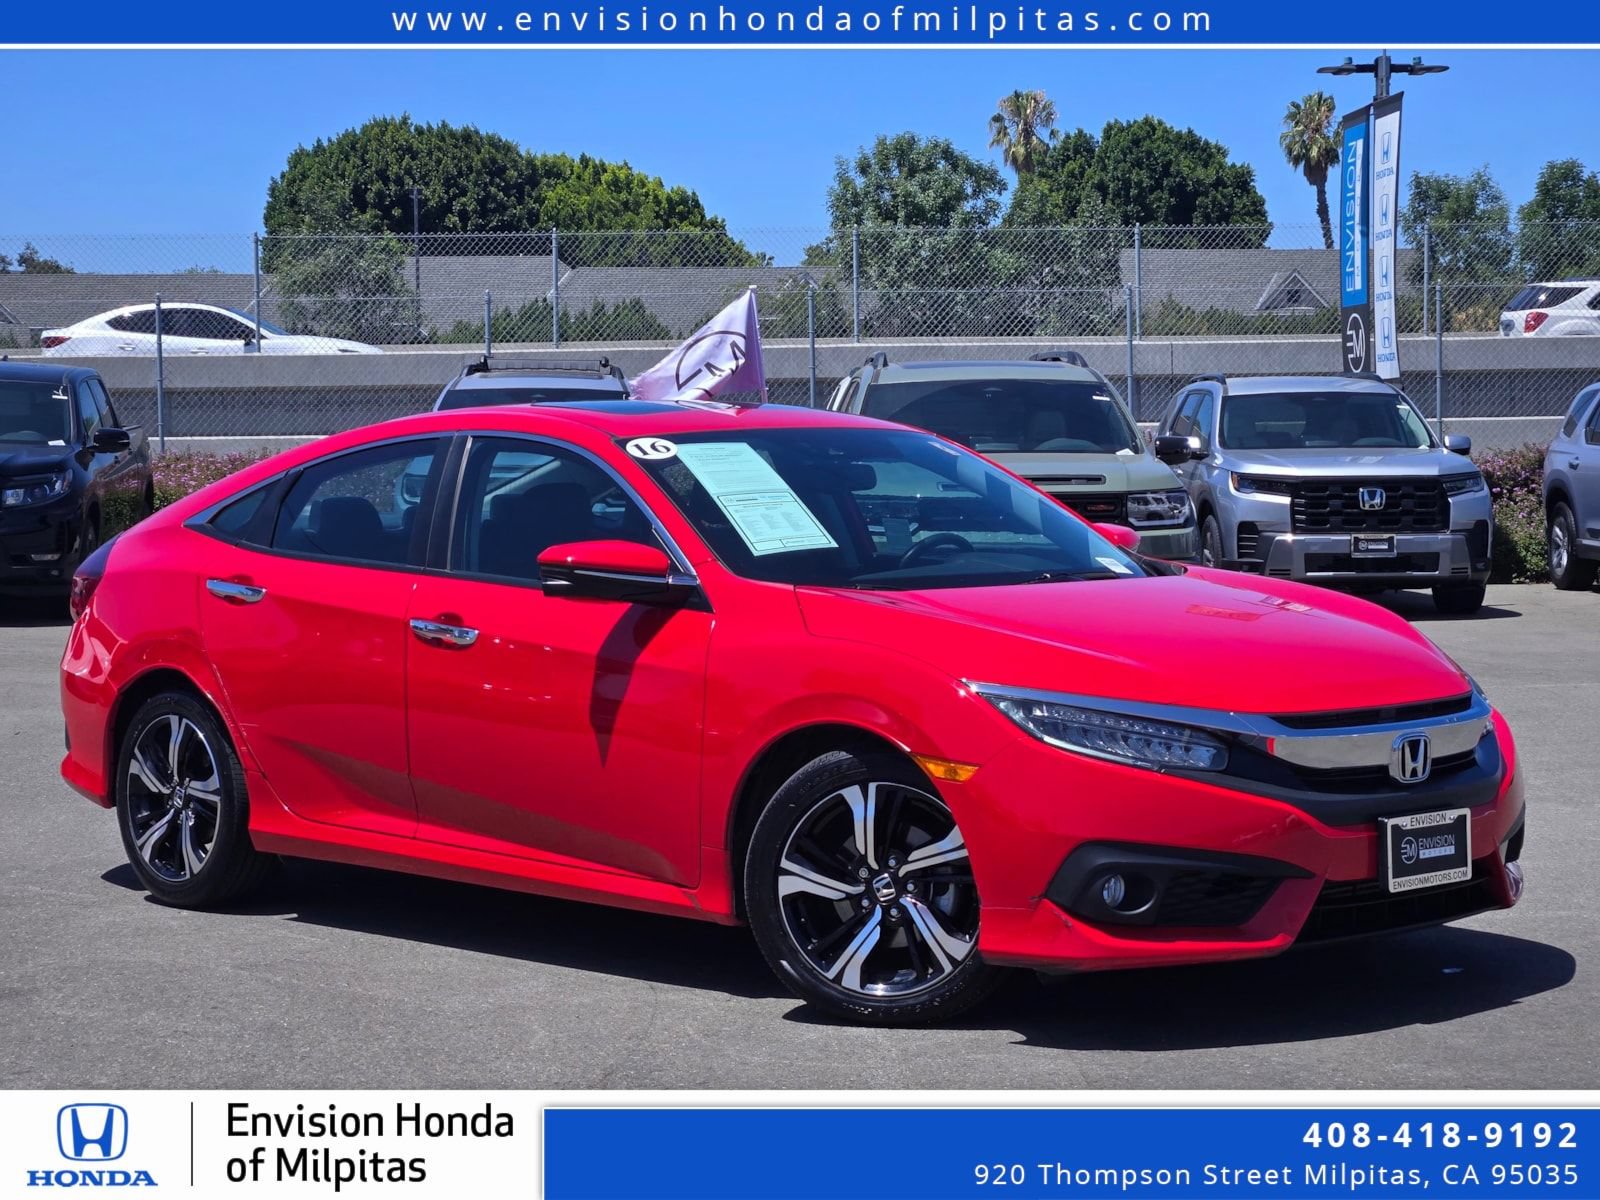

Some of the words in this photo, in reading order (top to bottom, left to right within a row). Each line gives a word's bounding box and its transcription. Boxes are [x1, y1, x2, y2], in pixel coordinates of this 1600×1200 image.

[1346, 141, 1357, 292] ENVISION
[631, 440, 671, 456] 16
[1410, 813, 1447, 827] ENVISION
[1418, 834, 1455, 849] ENVISION
[1393, 870, 1468, 890] ENVISIONMOTORS.COM
